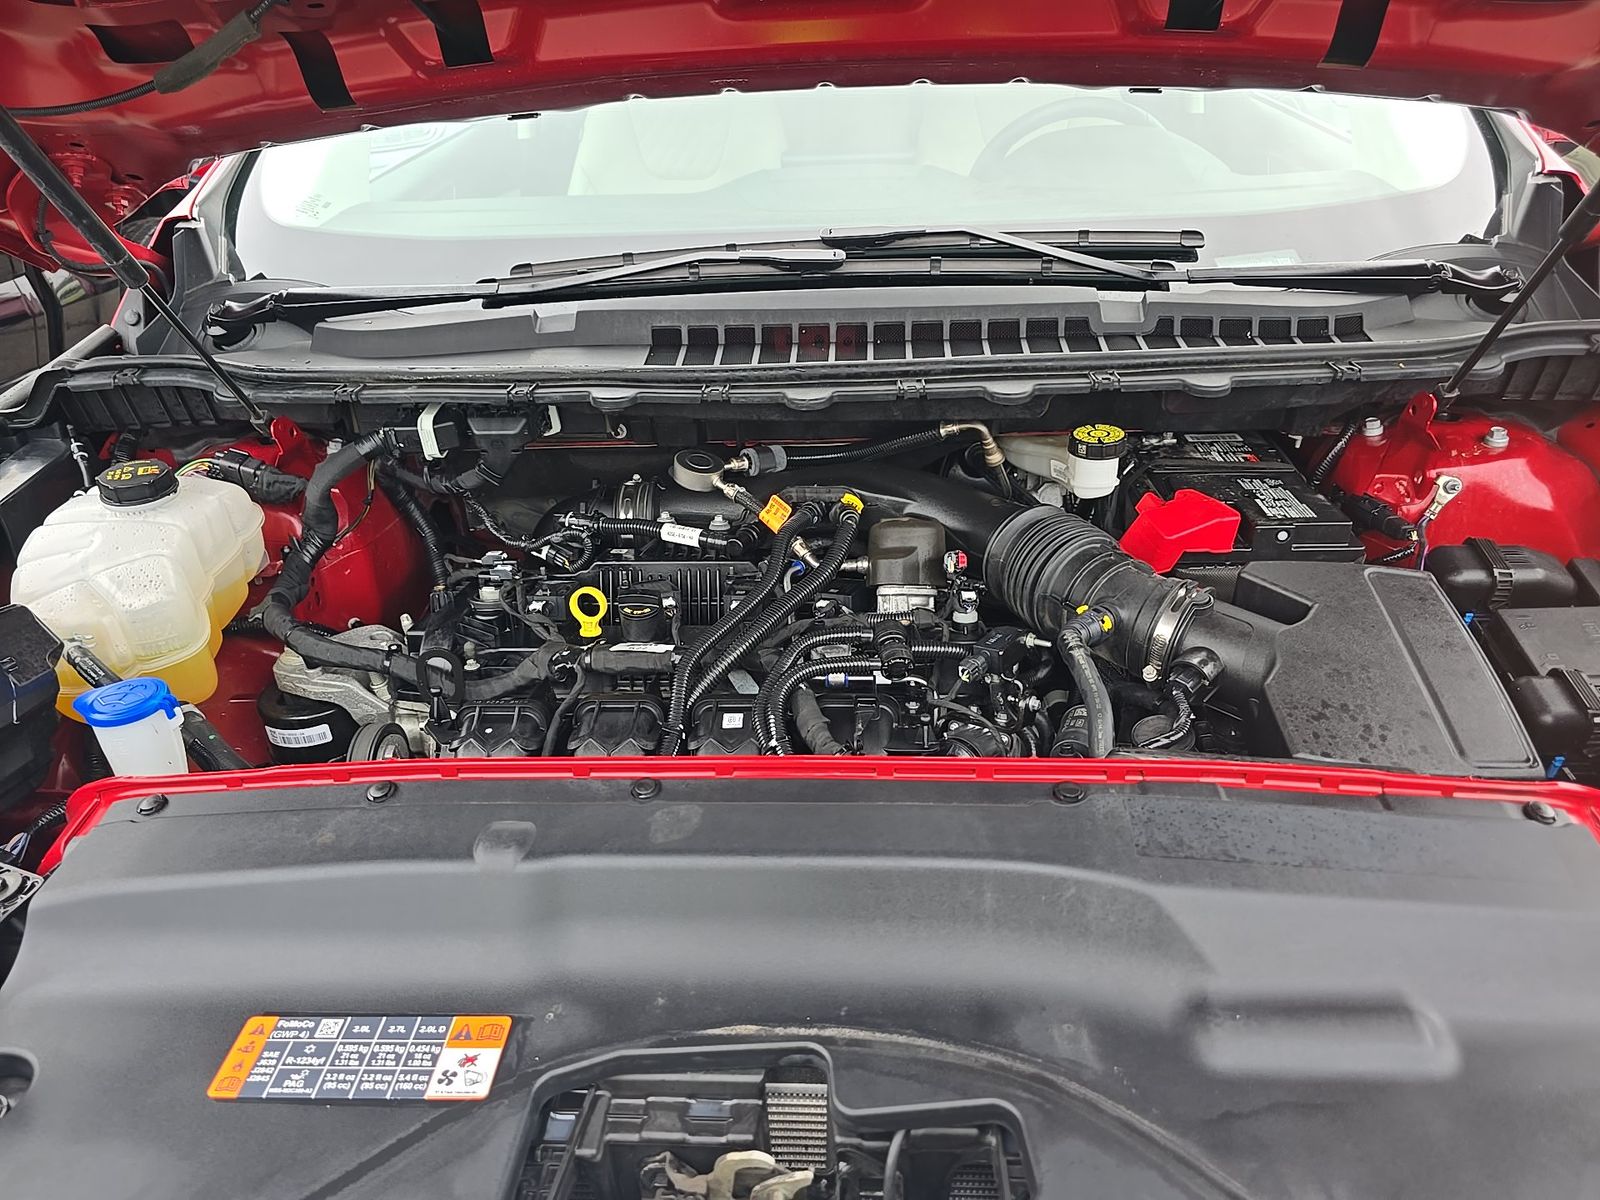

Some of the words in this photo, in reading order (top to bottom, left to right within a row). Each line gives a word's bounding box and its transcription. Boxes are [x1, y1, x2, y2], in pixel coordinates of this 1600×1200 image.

[277, 1020, 316, 1028] FoMoCo
[352, 1025, 370, 1033] 2.0L
[387, 1025, 406, 1033] 2.7L
[418, 1025, 437, 1033] 2.0L
[438, 1025, 446, 1033] D
[270, 1030, 298, 1039] (GWP
[299, 1030, 310, 1039] 4)
[359, 1045, 370, 1054] kg
[395, 1045, 405, 1054] kg
[431, 1045, 441, 1054] kg
[285, 1056, 326, 1066] R-1234yf
[338, 1082, 351, 1090] cc)
[374, 1082, 388, 1090] cc)
[414, 1082, 427, 1090] cc)
